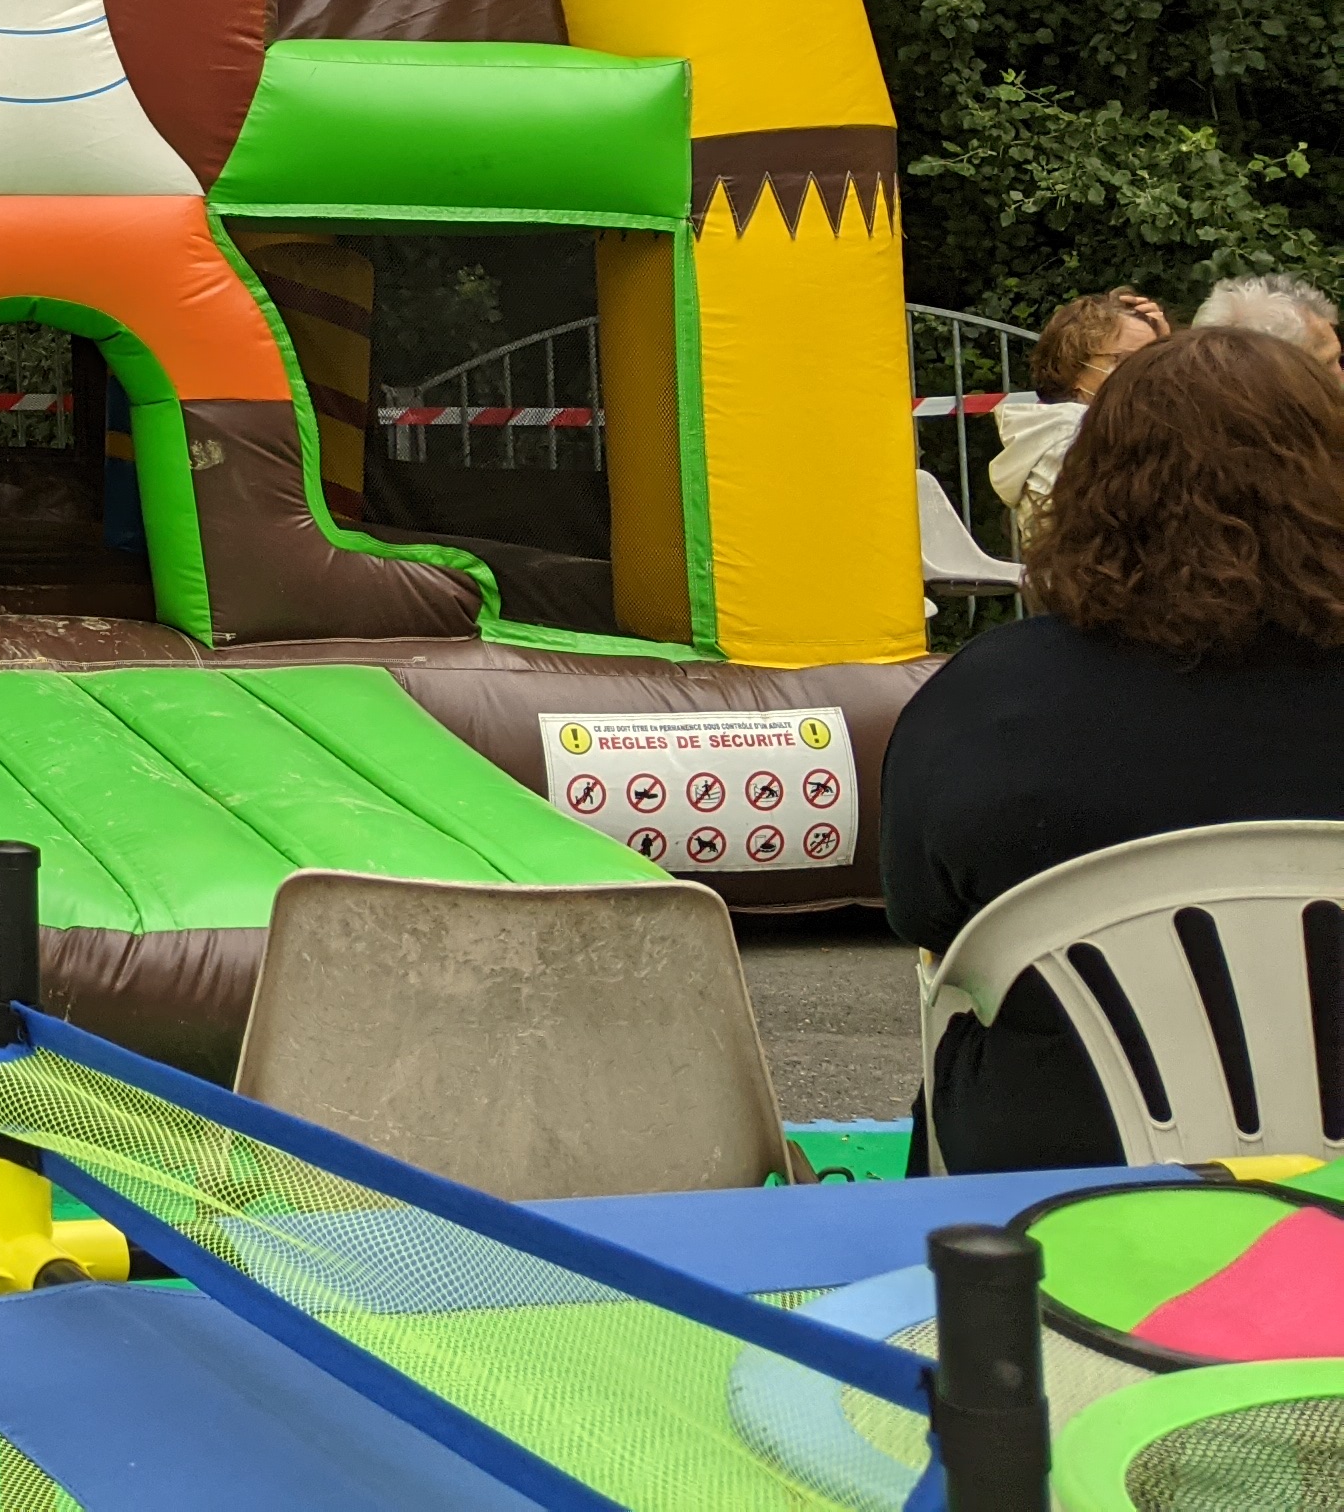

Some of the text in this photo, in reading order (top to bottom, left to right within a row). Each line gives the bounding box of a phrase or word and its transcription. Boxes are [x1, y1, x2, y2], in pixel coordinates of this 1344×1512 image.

[616, 725, 631, 733] DOIT
[659, 723, 702, 732] PERMANENCE
[703, 723, 720, 731] SOUS
[769, 721, 792, 729] ADULTE
[598, 730, 796, 750] RÈGLES DE SÉCURITÉ
